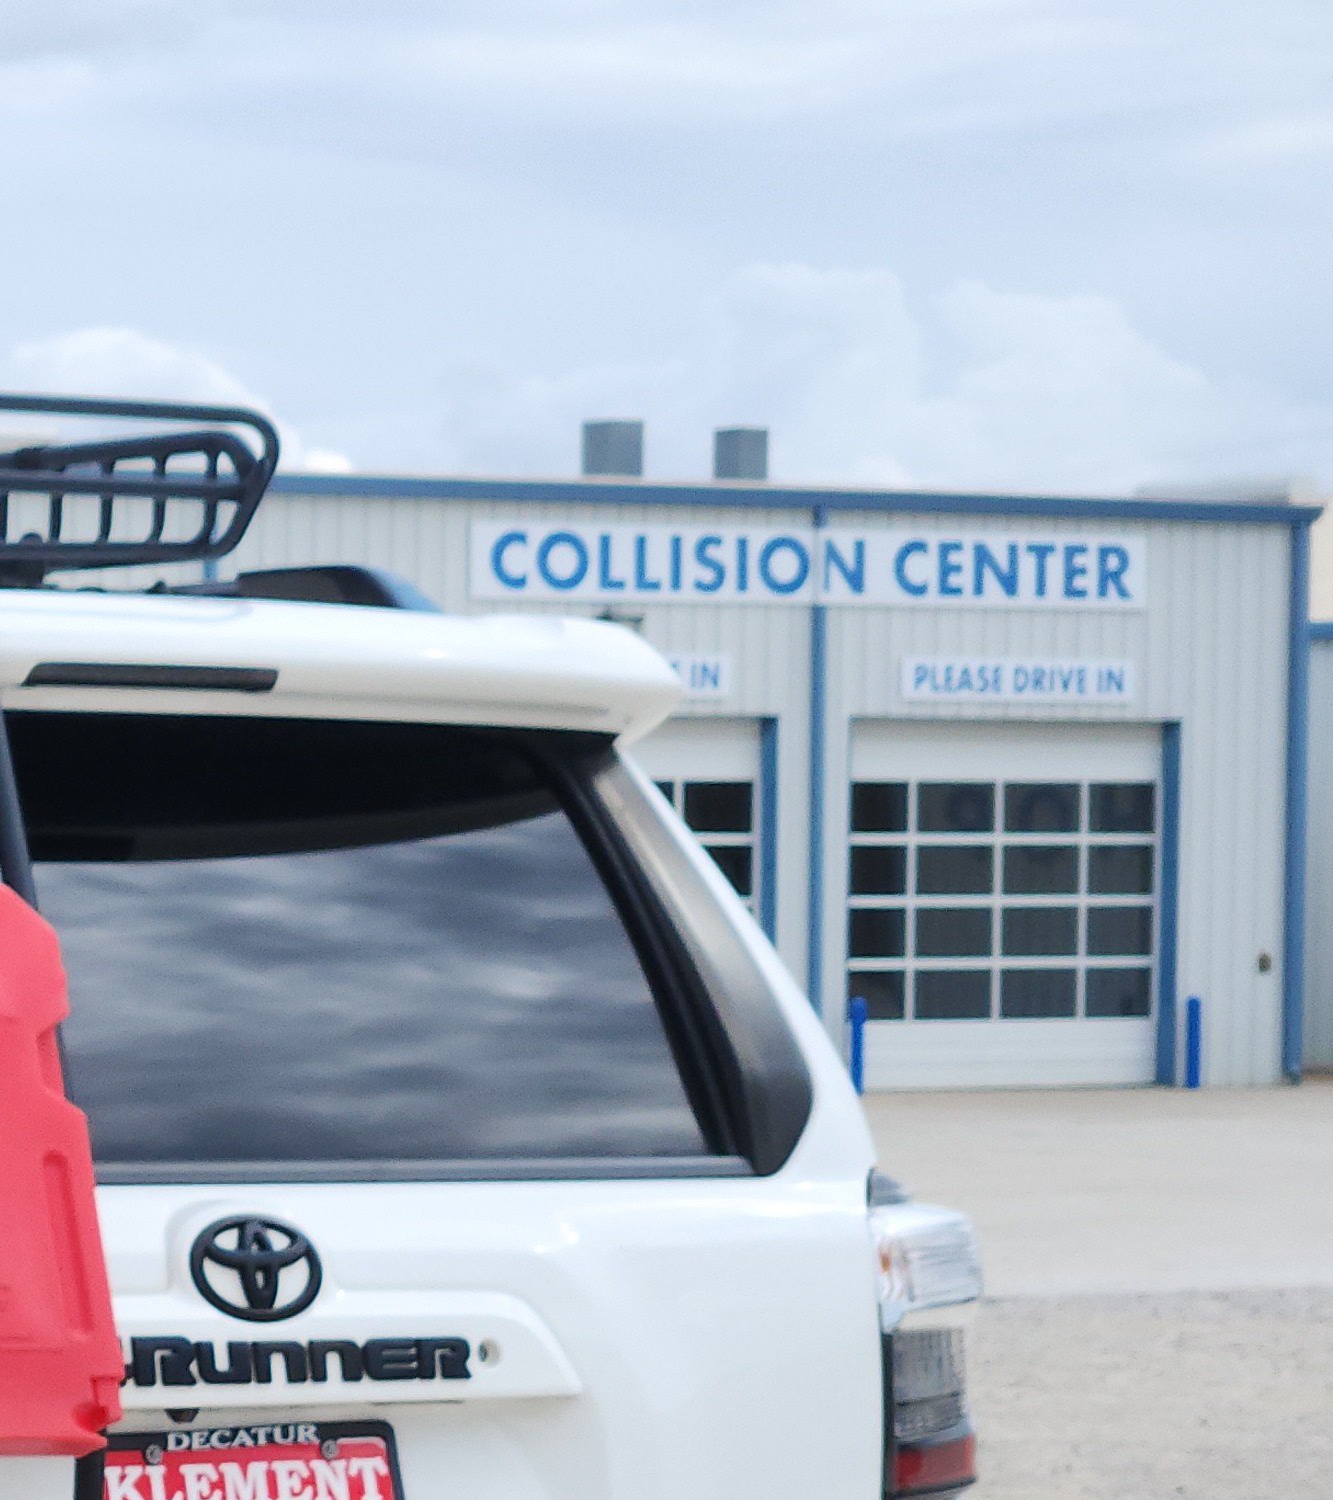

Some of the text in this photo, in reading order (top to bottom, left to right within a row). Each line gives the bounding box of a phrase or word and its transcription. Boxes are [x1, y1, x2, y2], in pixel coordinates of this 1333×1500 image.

[490, 530, 1132, 599] COLLISION CENTER
[690, 662, 720, 690] IN
[914, 663, 1125, 694] PLEASE DRIVE IN
[119, 1335, 472, 1386] RUNNER
[167, 1424, 319, 1451] DECATUR
